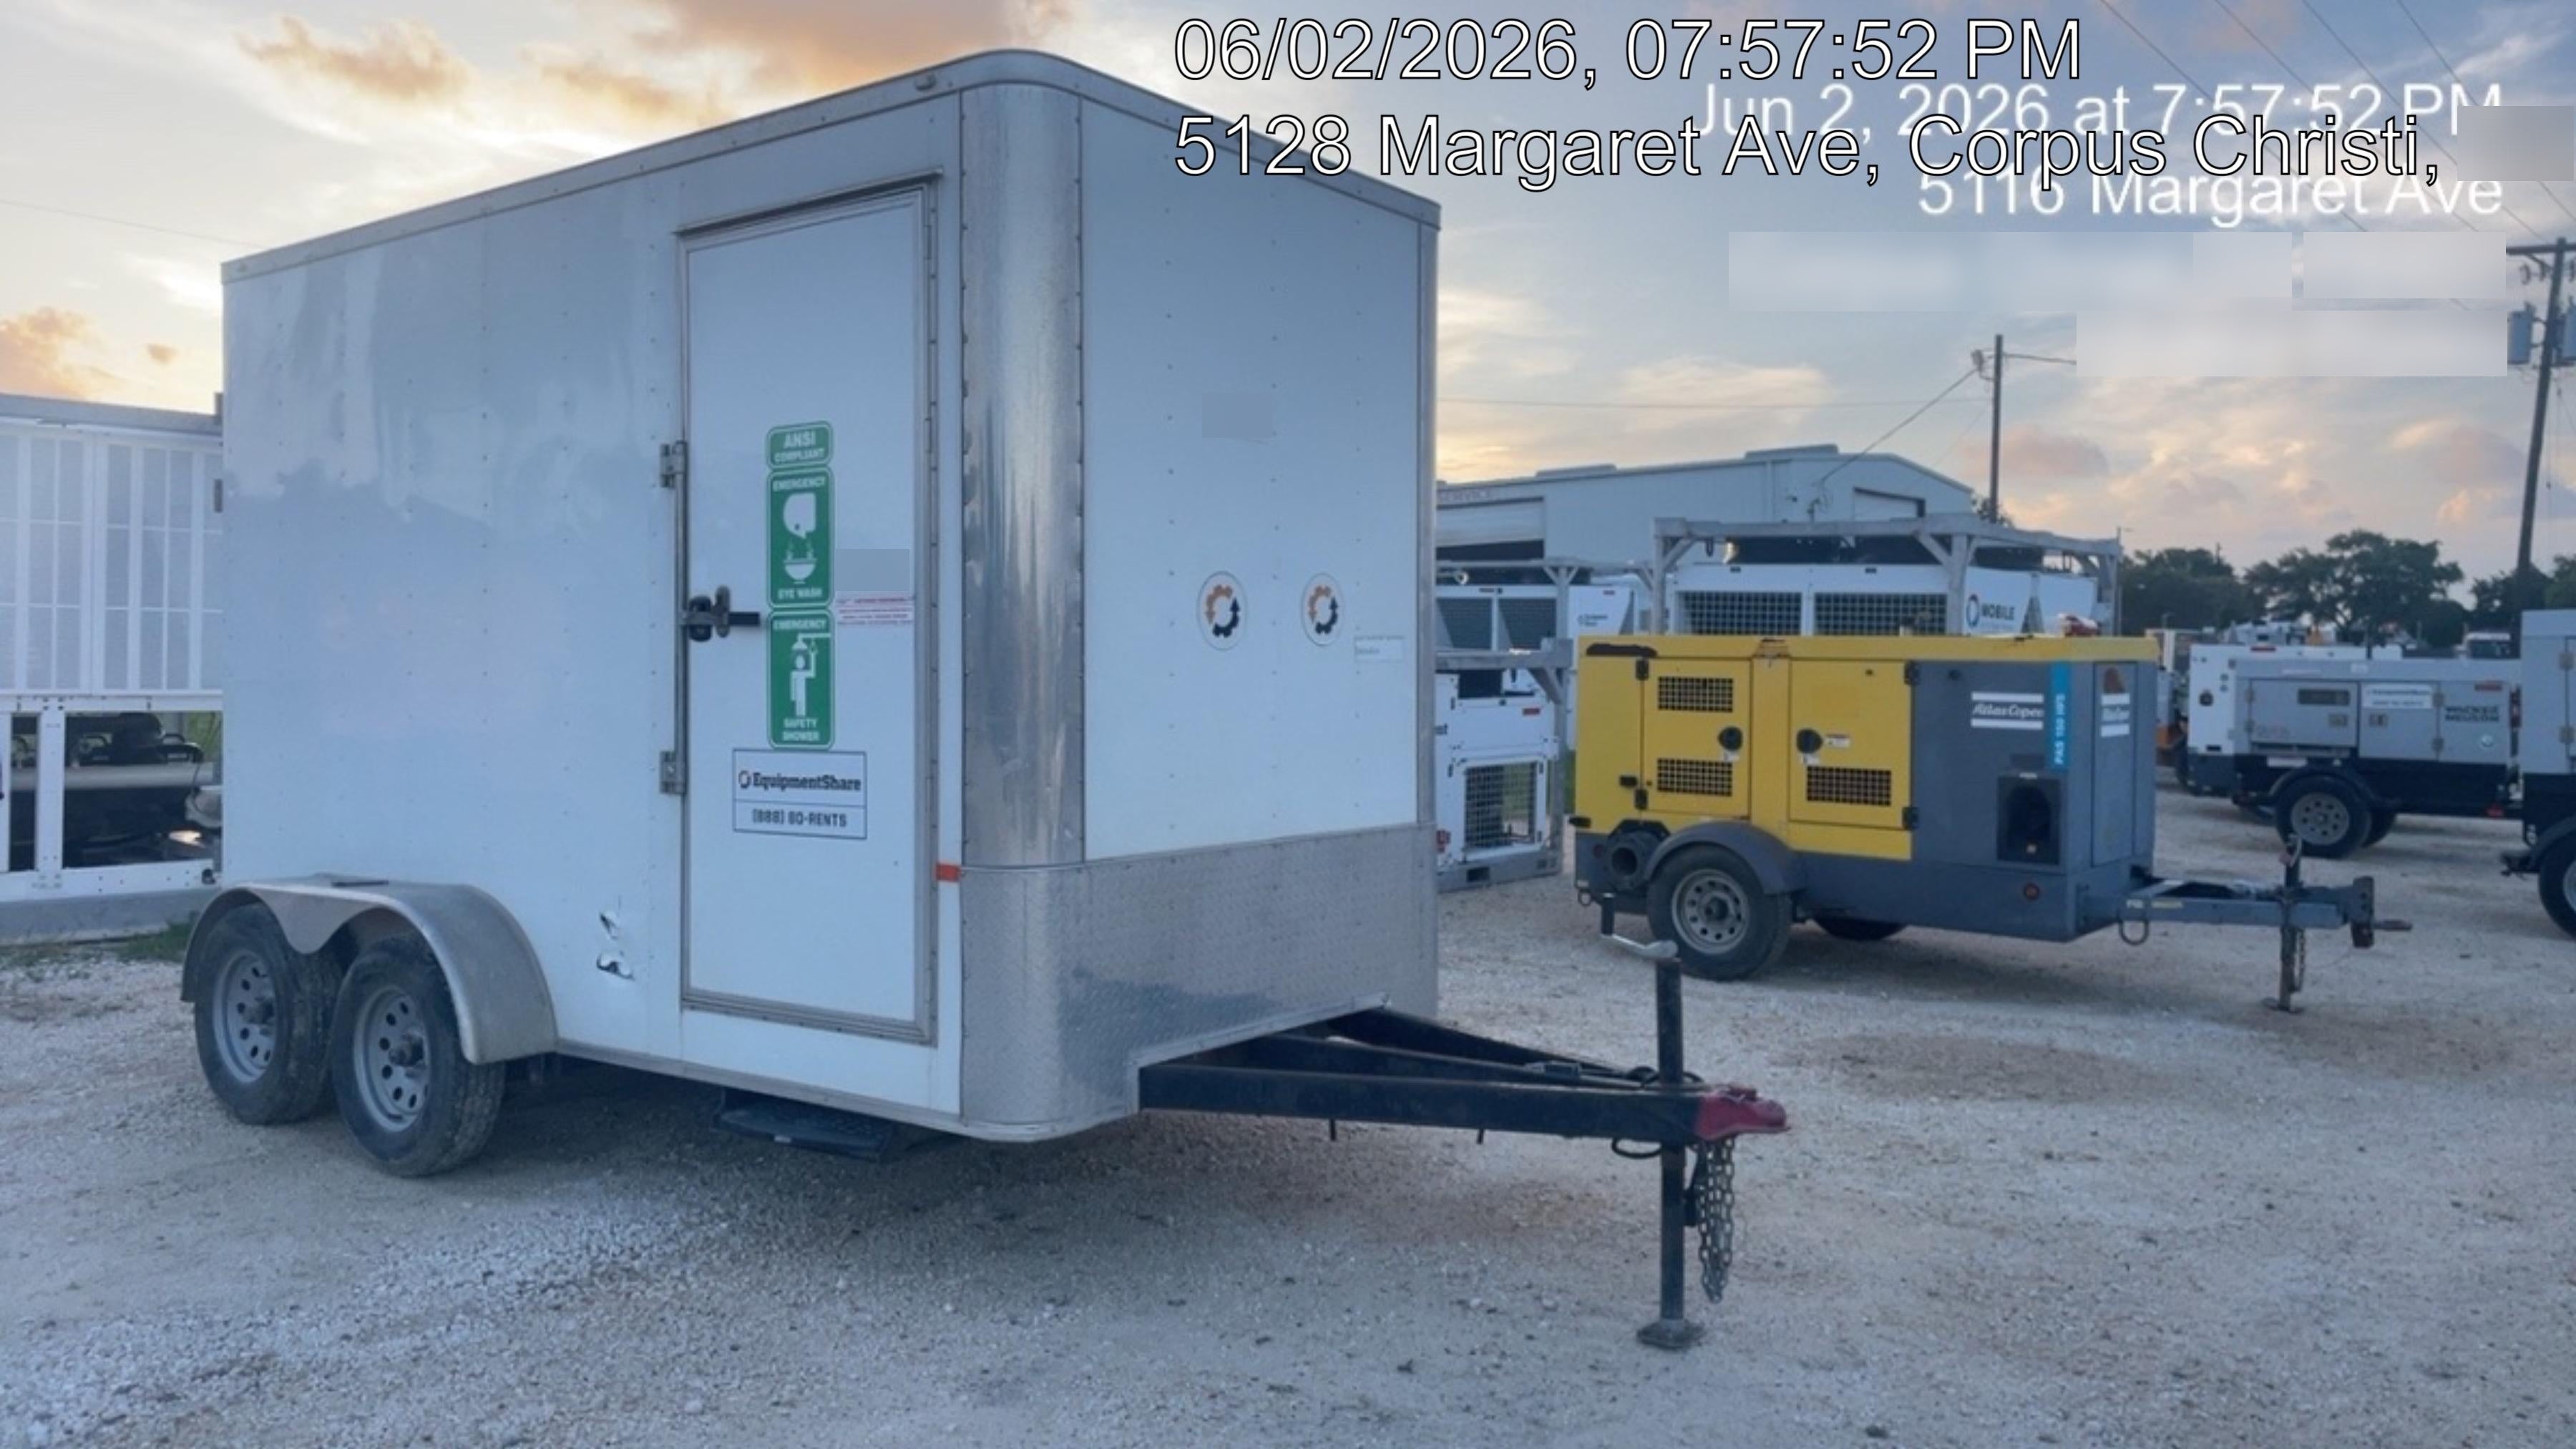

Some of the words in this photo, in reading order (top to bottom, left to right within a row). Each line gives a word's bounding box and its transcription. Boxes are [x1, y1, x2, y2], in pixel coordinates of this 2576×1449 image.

[784, 431, 816, 449] ANSI
[774, 448, 825, 464] COMPLIANT
[772, 477, 826, 492] EMERGENCY
[778, 588, 795, 600] EYE
[797, 587, 823, 598] WASH
[773, 620, 826, 630] EMERGENCY
[1973, 703, 2006, 716] Atlas
[783, 718, 818, 729] SAFETY
[782, 731, 820, 742] SHOWER
[753, 771, 862, 791] EquipmentShare
